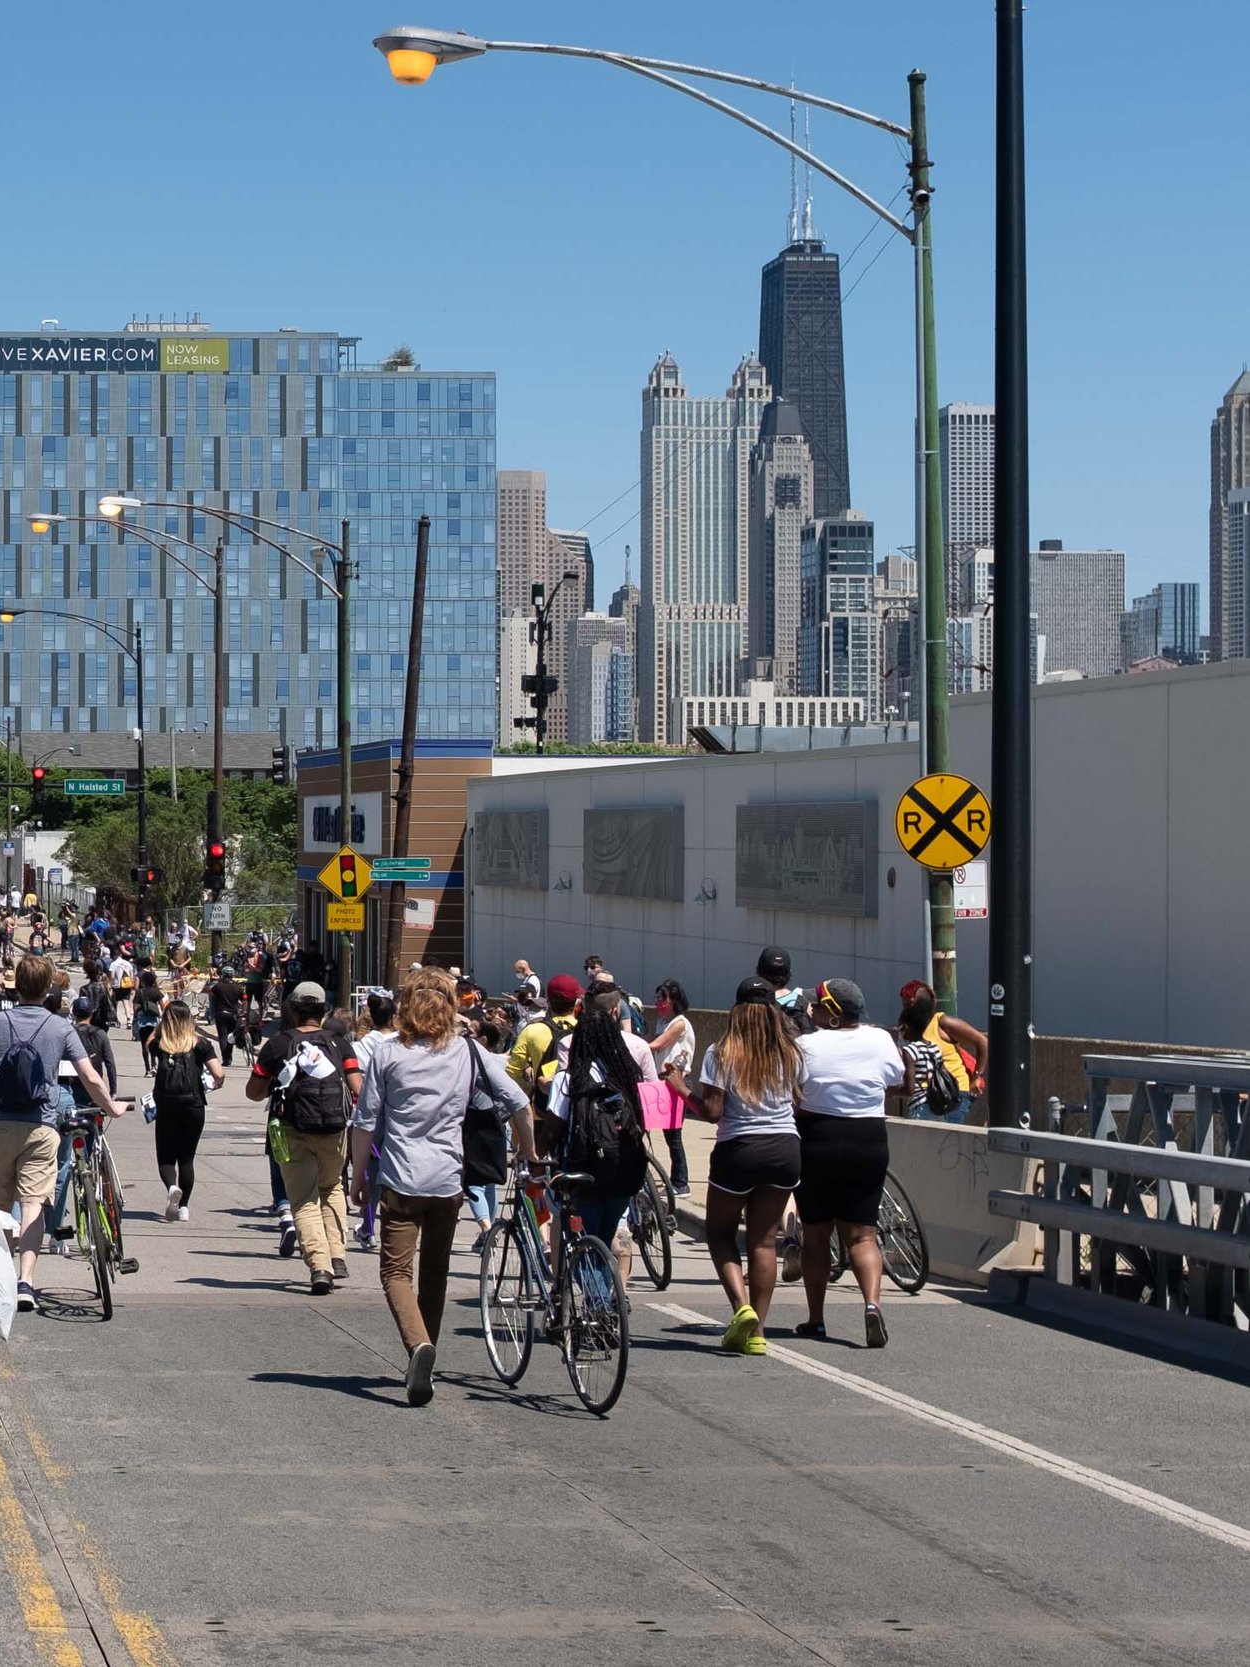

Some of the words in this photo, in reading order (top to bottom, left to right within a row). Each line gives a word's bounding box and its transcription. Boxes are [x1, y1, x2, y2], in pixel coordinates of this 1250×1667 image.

[166, 344, 198, 354] NOW
[166, 355, 220, 365] LEASING
[68, 783, 75, 791] N
[78, 783, 108, 791] Halsted
[112, 783, 121, 791] St
[903, 811, 922, 834] R
[967, 809, 986, 832] R
